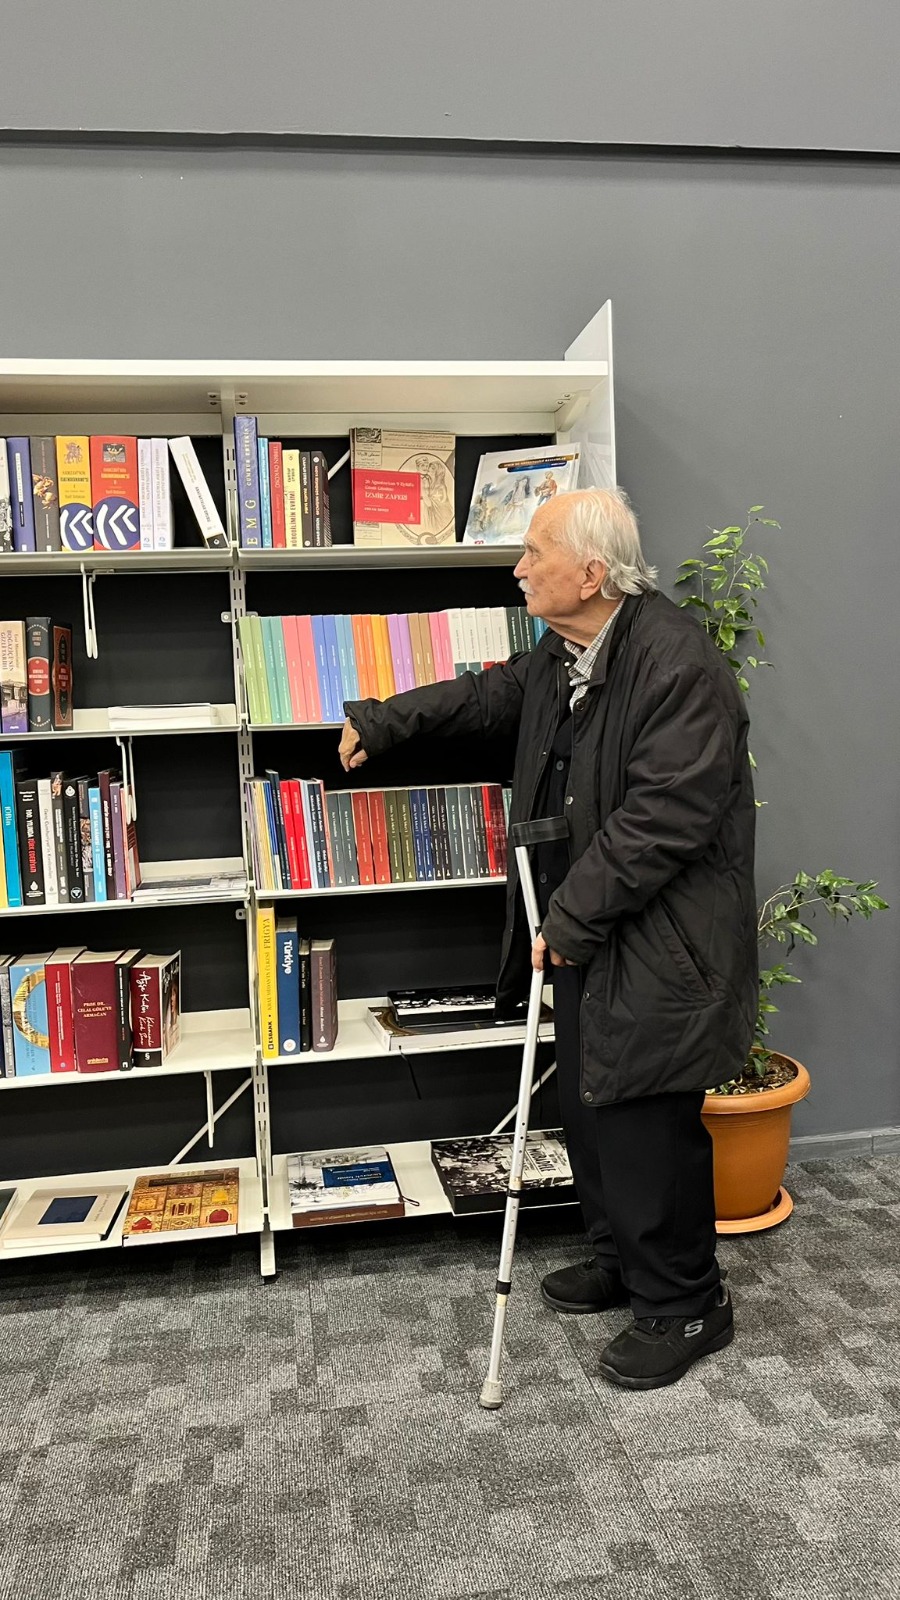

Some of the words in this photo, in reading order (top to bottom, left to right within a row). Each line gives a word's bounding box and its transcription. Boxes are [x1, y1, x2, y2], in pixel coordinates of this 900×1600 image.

[262, 918, 271, 949] FRİGYA
[282, 939, 293, 974] Türkiye
[135, 970, 152, 992] Ayşe
[140, 993, 150, 1014] Kulin
